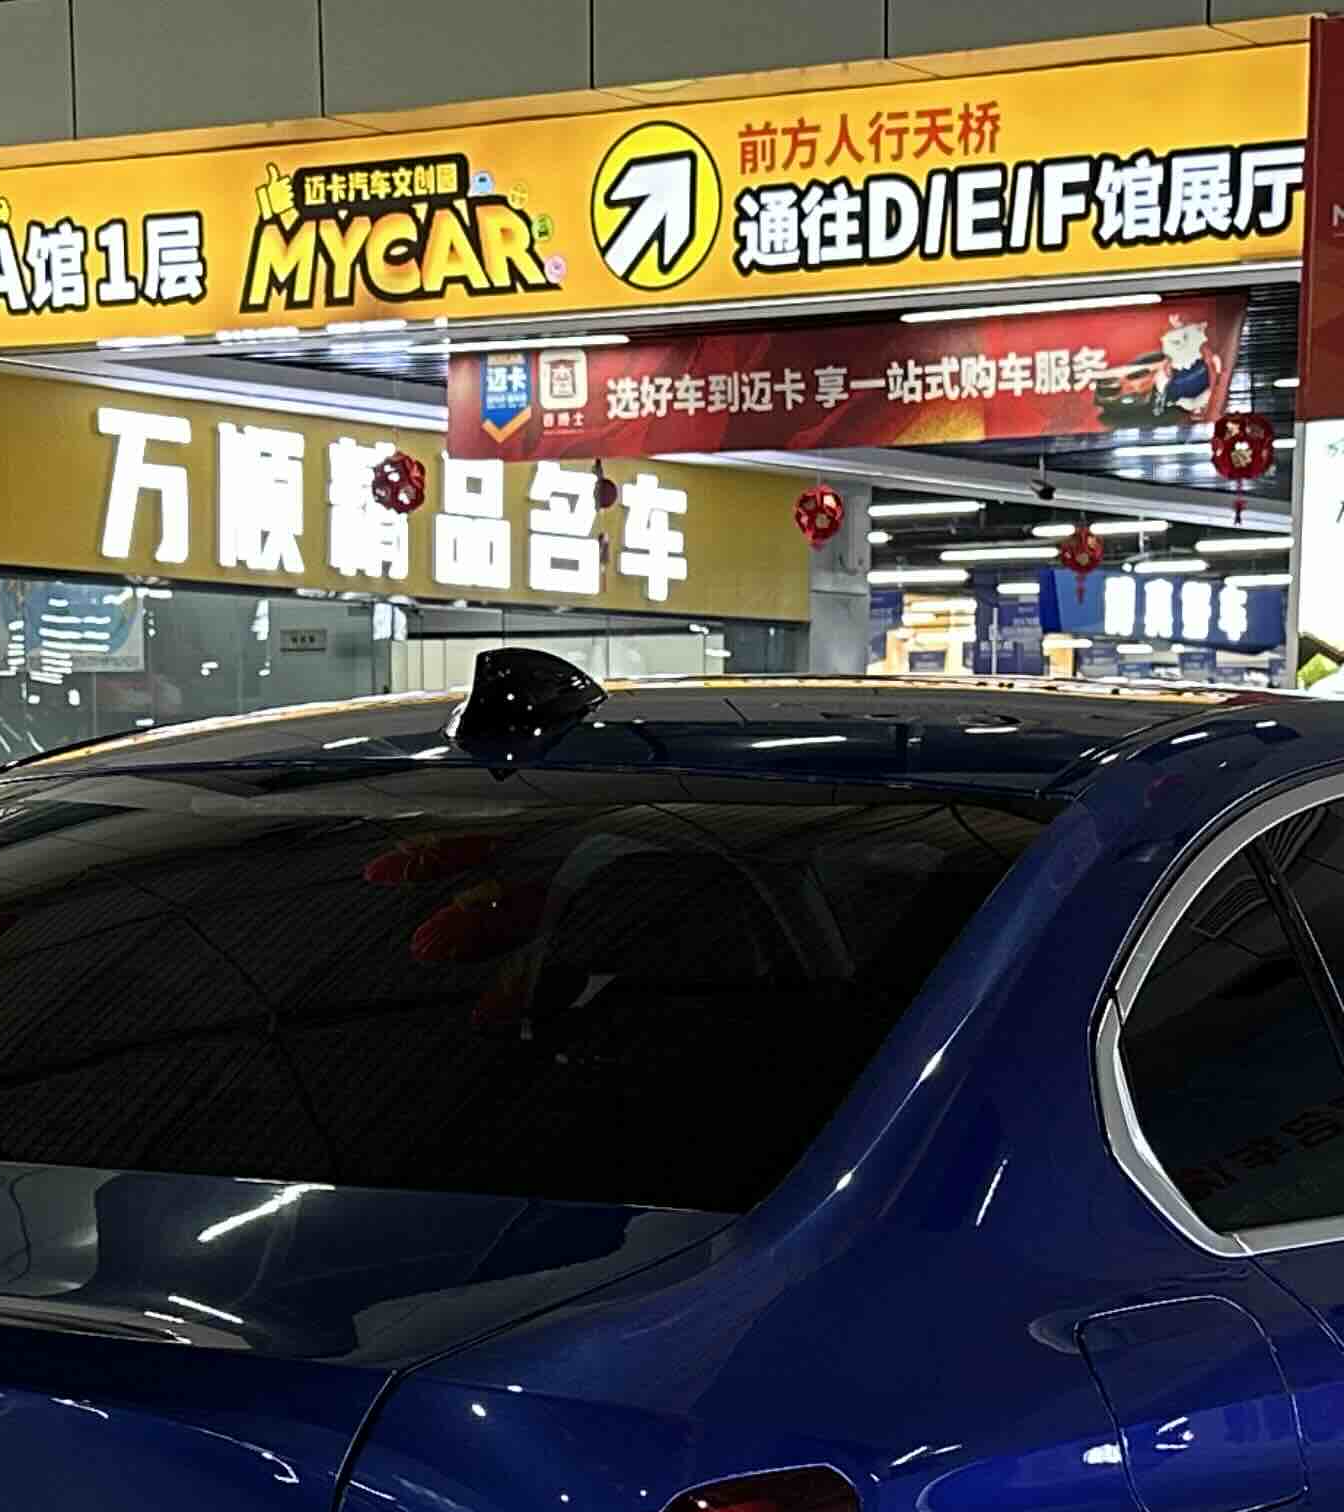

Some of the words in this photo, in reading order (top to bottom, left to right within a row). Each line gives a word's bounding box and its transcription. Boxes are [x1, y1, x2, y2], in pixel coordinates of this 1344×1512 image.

[303, 161, 459, 206] 迈卡汽车文创园
[738, 101, 1001, 175] 前方人行天桥
[737, 145, 1305, 270] 通往D/E/F馆展厅
[243, 199, 556, 313] MYCAR
[607, 364, 805, 419] 选好车到迈卡
[814, 347, 1112, 409] 享一站式购车服务
[97, 407, 689, 601] 万顺精品名车
